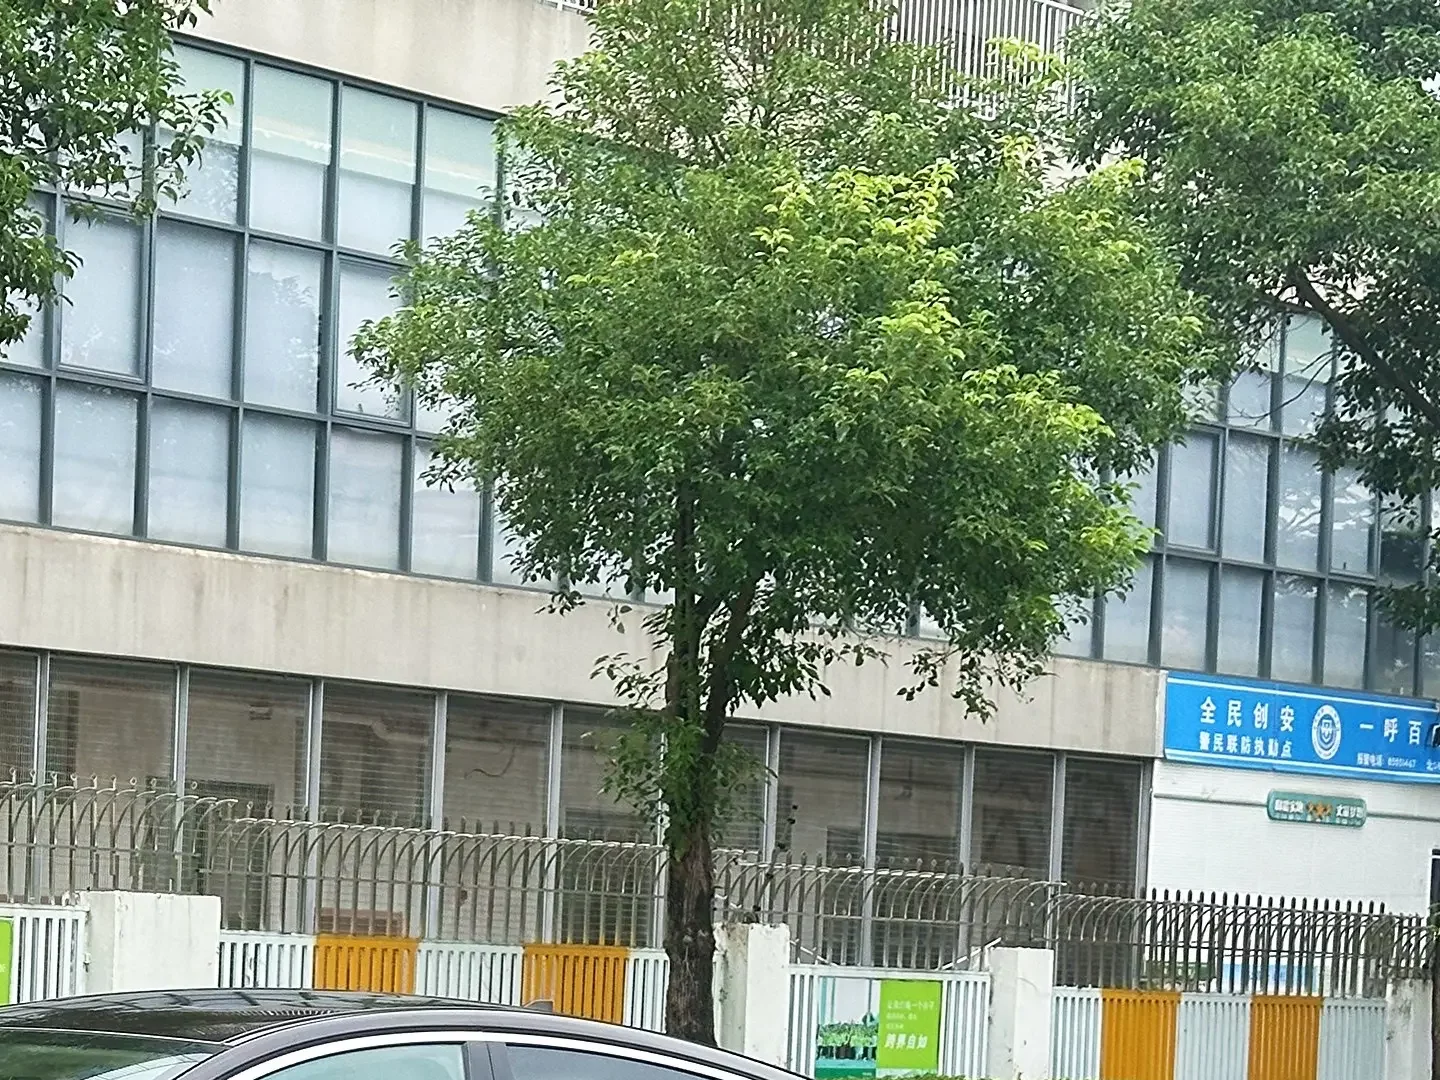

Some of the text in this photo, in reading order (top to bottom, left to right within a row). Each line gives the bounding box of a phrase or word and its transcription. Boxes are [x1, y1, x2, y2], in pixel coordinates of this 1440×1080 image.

[1200, 696, 1295, 732] 全民创安
[1199, 731, 1293, 758] 警民联防执勤点
